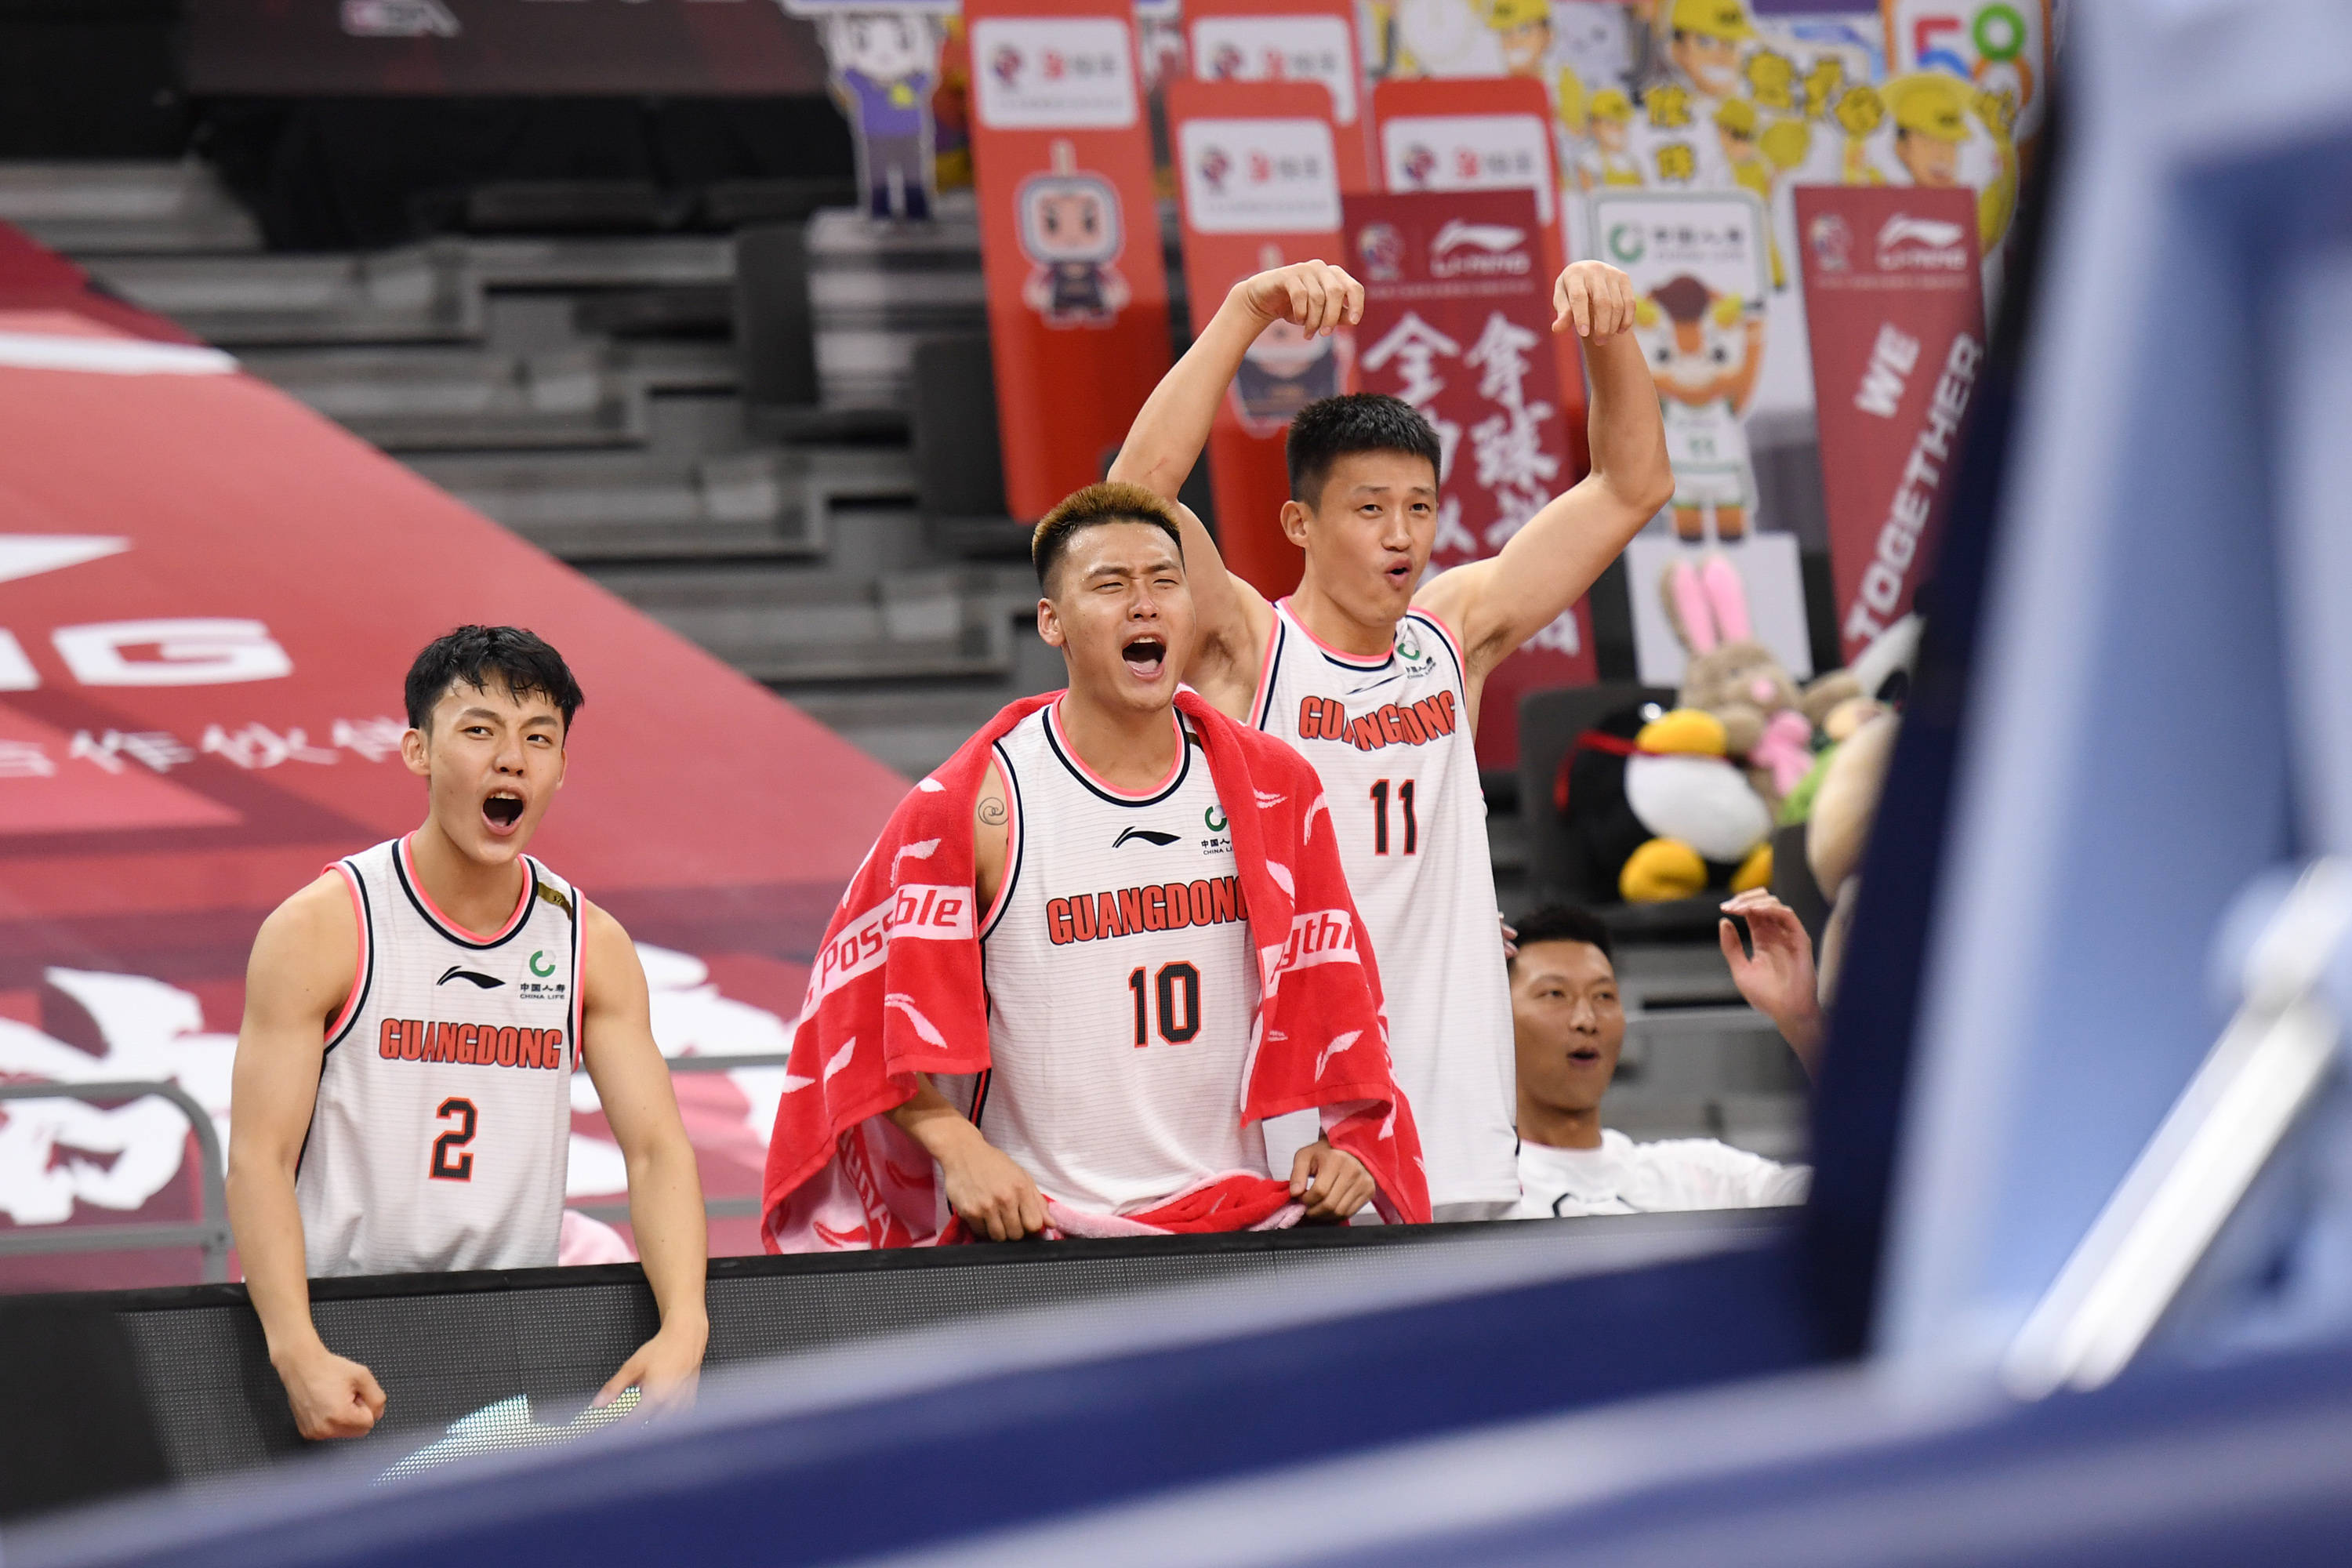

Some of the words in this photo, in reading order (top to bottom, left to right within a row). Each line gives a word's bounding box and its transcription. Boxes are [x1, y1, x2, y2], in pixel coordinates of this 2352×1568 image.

[1853, 321, 1921, 419] WE
[1843, 332, 1984, 641] TOGETHER
[1369, 779, 1418, 856] 11
[521, 982, 566, 993] 中国人寿
[1127, 960, 1201, 1048] 10
[379, 1018, 563, 1070] GUANGDONG
[429, 1097, 478, 1181] 2
